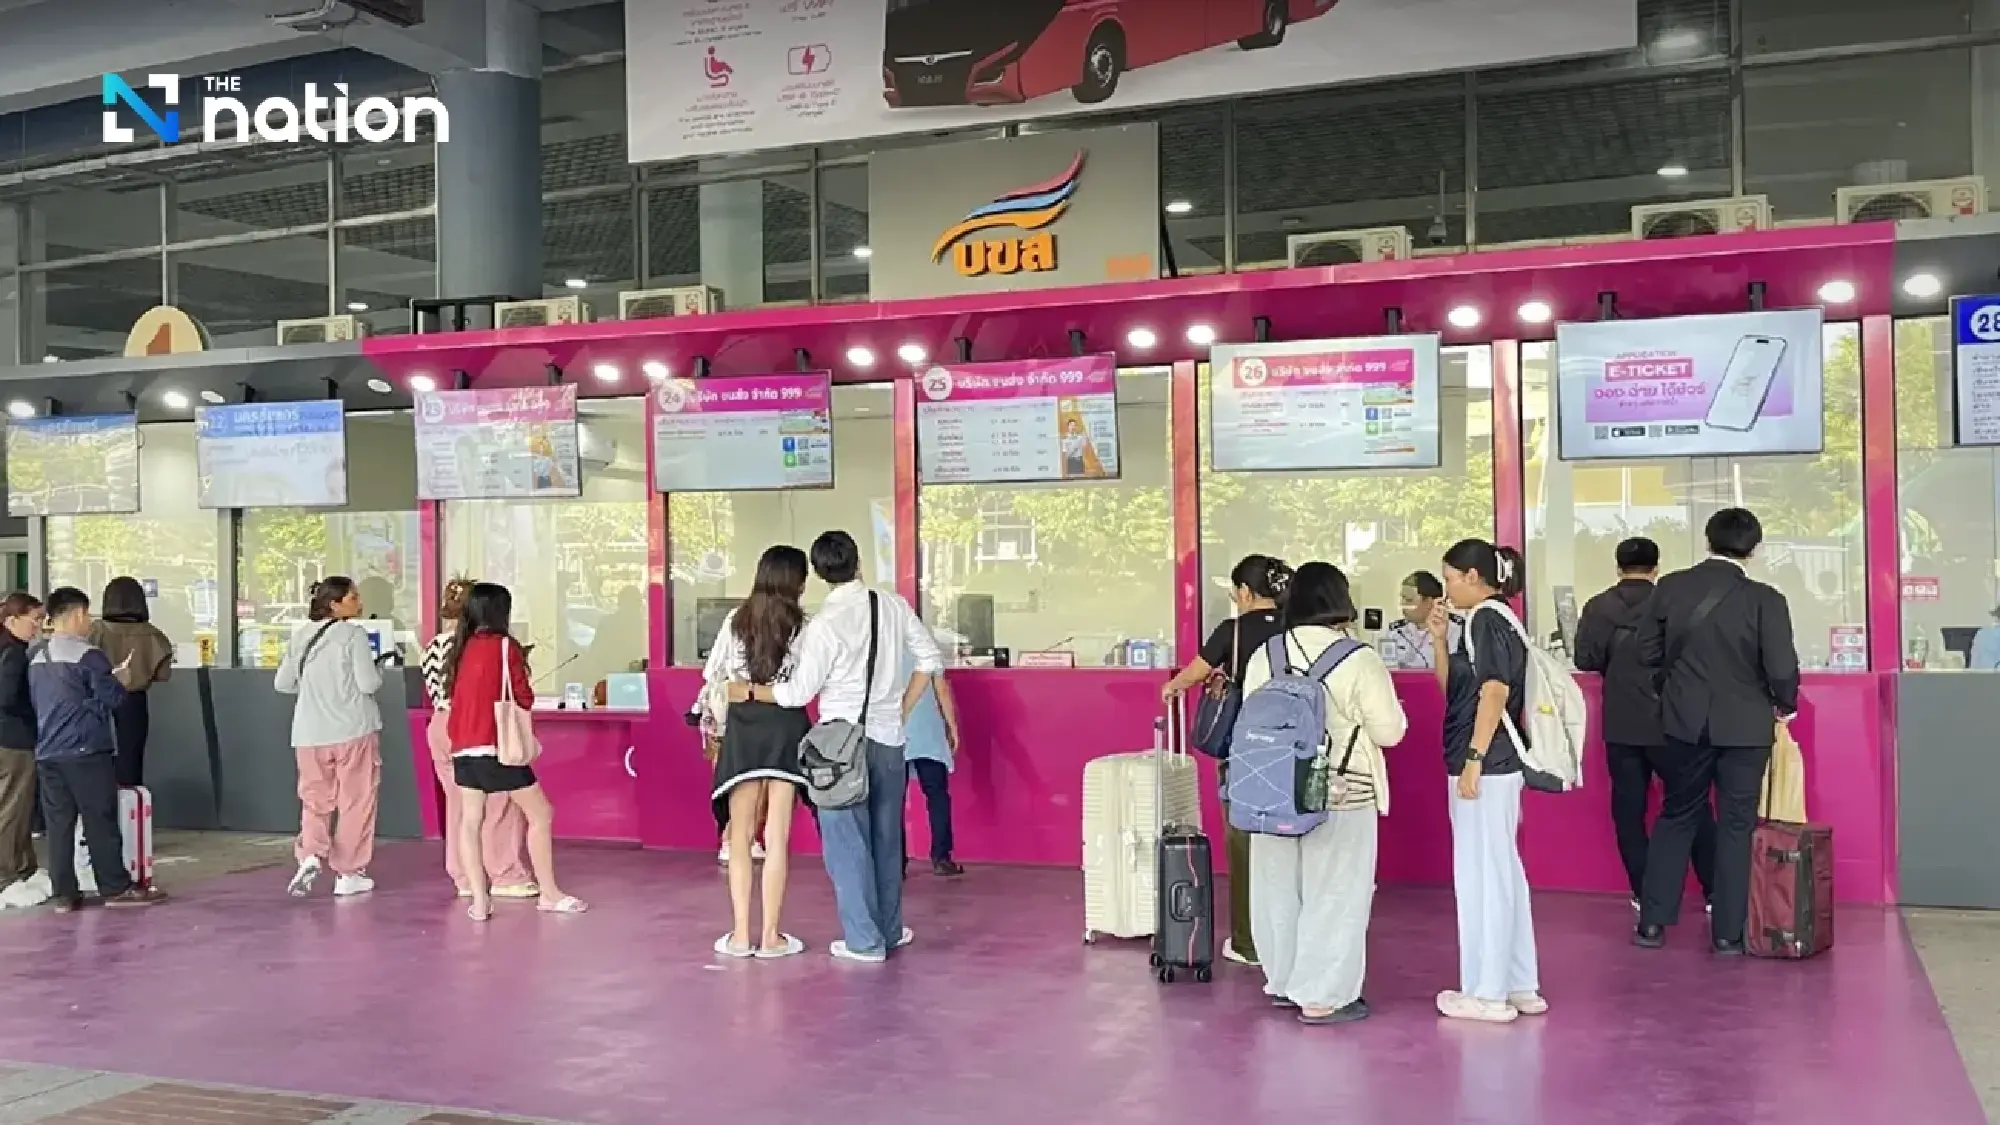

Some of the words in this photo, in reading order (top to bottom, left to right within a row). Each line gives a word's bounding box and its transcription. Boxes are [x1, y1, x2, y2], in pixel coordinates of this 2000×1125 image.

[953, 231, 1057, 276] บขส
[1244, 365, 1263, 380] 26
[1364, 361, 1387, 372] 999
[1608, 362, 1690, 378] E-TICKET
[928, 377, 947, 392] 25
[1059, 370, 1084, 383] 999
[664, 391, 681, 404] 24
[781, 387, 803, 400] 999
